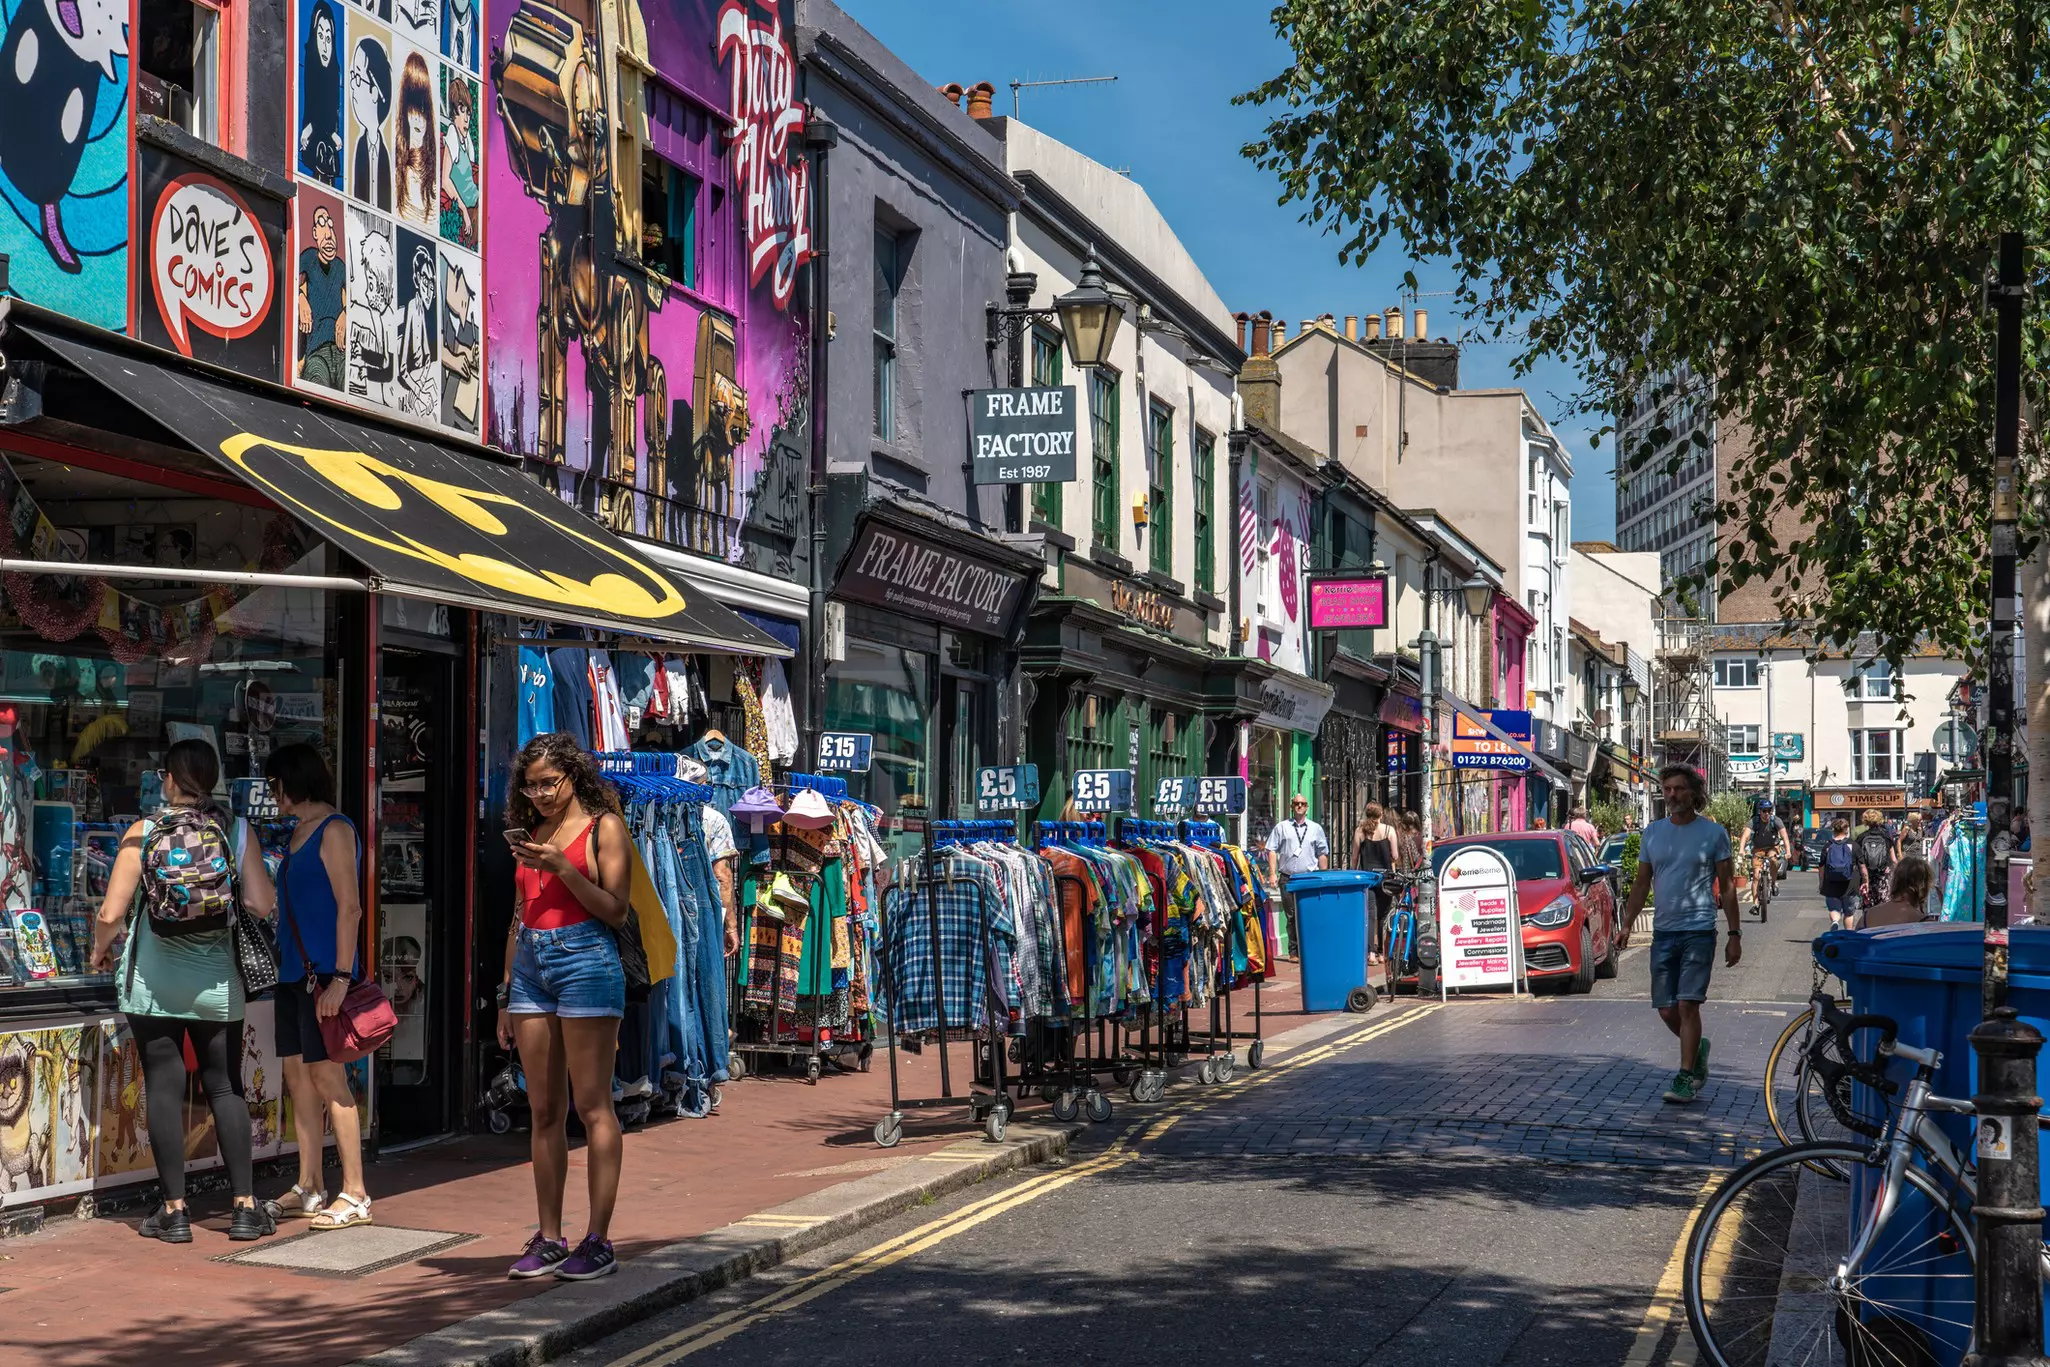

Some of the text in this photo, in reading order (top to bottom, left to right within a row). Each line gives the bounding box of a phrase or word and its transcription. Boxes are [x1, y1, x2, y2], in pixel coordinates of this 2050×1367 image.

[718, 7, 803, 159] Dirty
[736, 123, 808, 300] Harry
[986, 391, 1063, 417] FRAME
[976, 431, 1074, 458] FACTORY
[999, 465, 1051, 479] Est 1987
[856, 531, 1016, 615] FRAME FACTORY
[820, 736, 855, 757] £15
[1474, 742, 1491, 753] TO
[820, 758, 852, 768] RAIL
[1457, 755, 1526, 766] 01273 876200
[981, 768, 1016, 797] £5
[1078, 773, 1110, 799] £5
[1157, 779, 1183, 802] £5
[1200, 779, 1228, 802] £5
[1074, 800, 1111, 810] RAIL
[1197, 803, 1229, 812] RAIL
[1847, 795, 1900, 803] TIMESLIP
[1473, 919, 1505, 927] Handmade
[1467, 948, 1507, 956] Commissions
